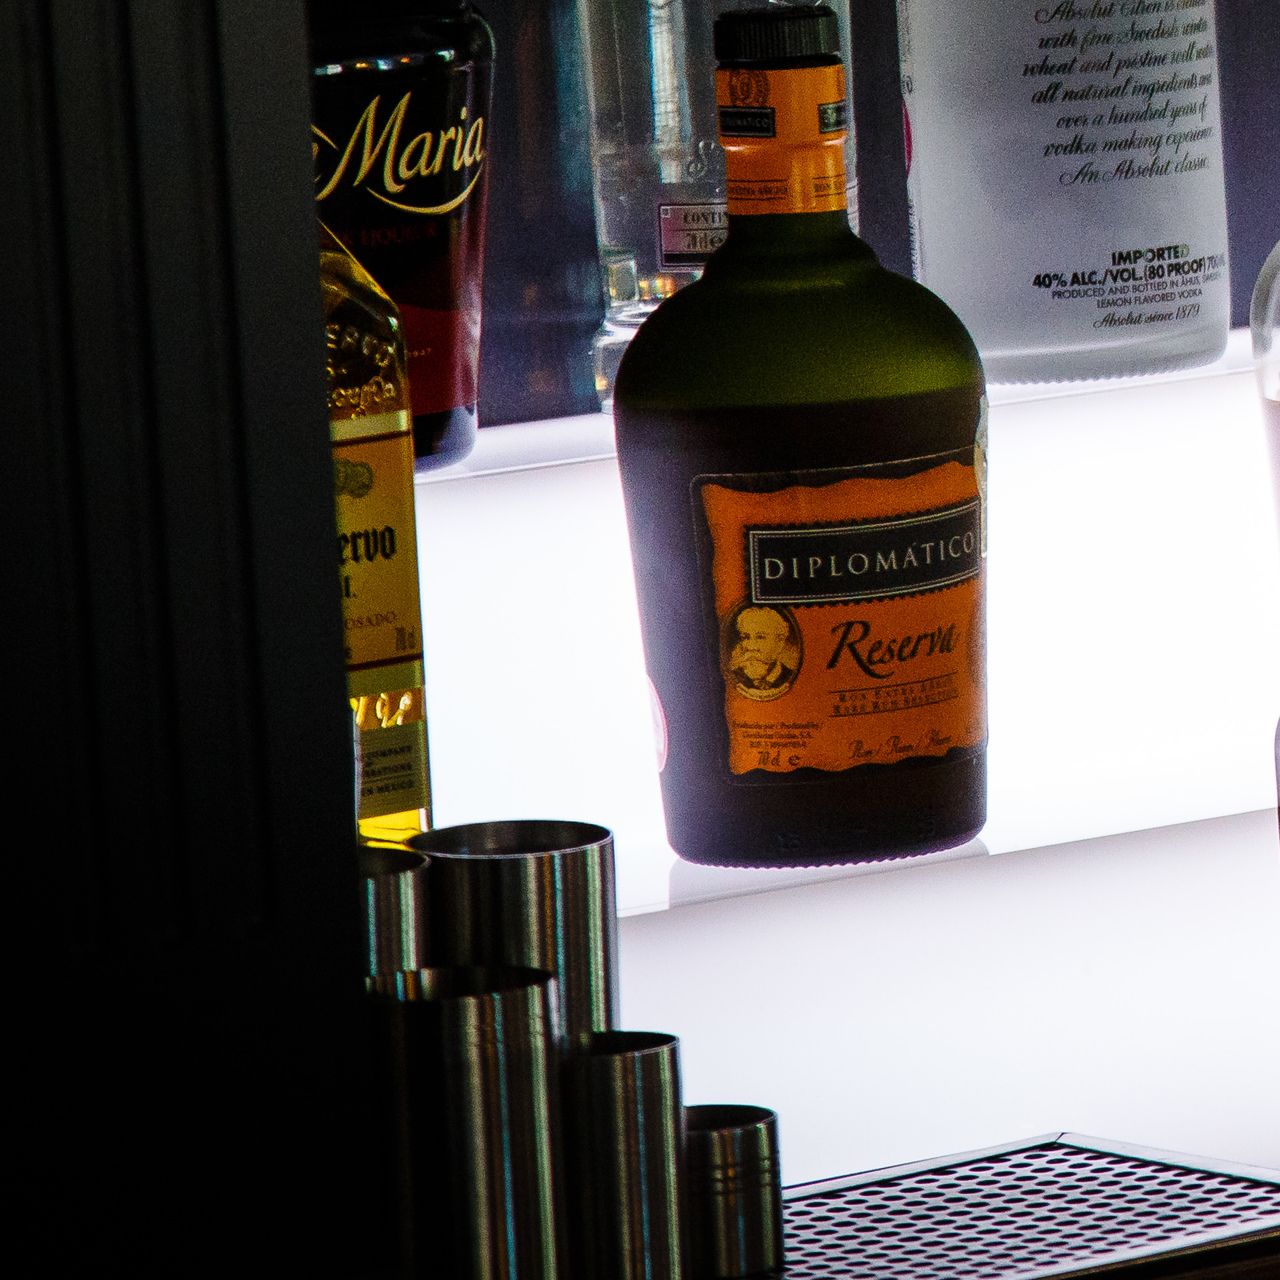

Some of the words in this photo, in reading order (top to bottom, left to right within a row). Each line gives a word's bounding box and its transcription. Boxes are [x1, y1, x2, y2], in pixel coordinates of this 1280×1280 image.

[1038, 29, 1078, 50] with
[1022, 54, 1077, 77] wheat
[1031, 81, 1063, 104] all
[1062, 75, 1132, 103] natural
[314, 91, 486, 201] Maria
[1043, 135, 1098, 157] vodka
[1102, 129, 1163, 156] making
[1111, 244, 1191, 266] IMPORTED
[1033, 272, 1068, 288] 40%
[1052, 287, 1105, 300] PRODUCED
[1108, 285, 1130, 296] AND
[1131, 281, 1168, 294] BOTTLED
[1096, 295, 1132, 309] LEMON
[1133, 291, 1176, 304] FLAVORED
[1177, 288, 1203, 300] VODKA
[1093, 311, 1142, 329] Absolut
[825, 620, 958, 680] Reserva
